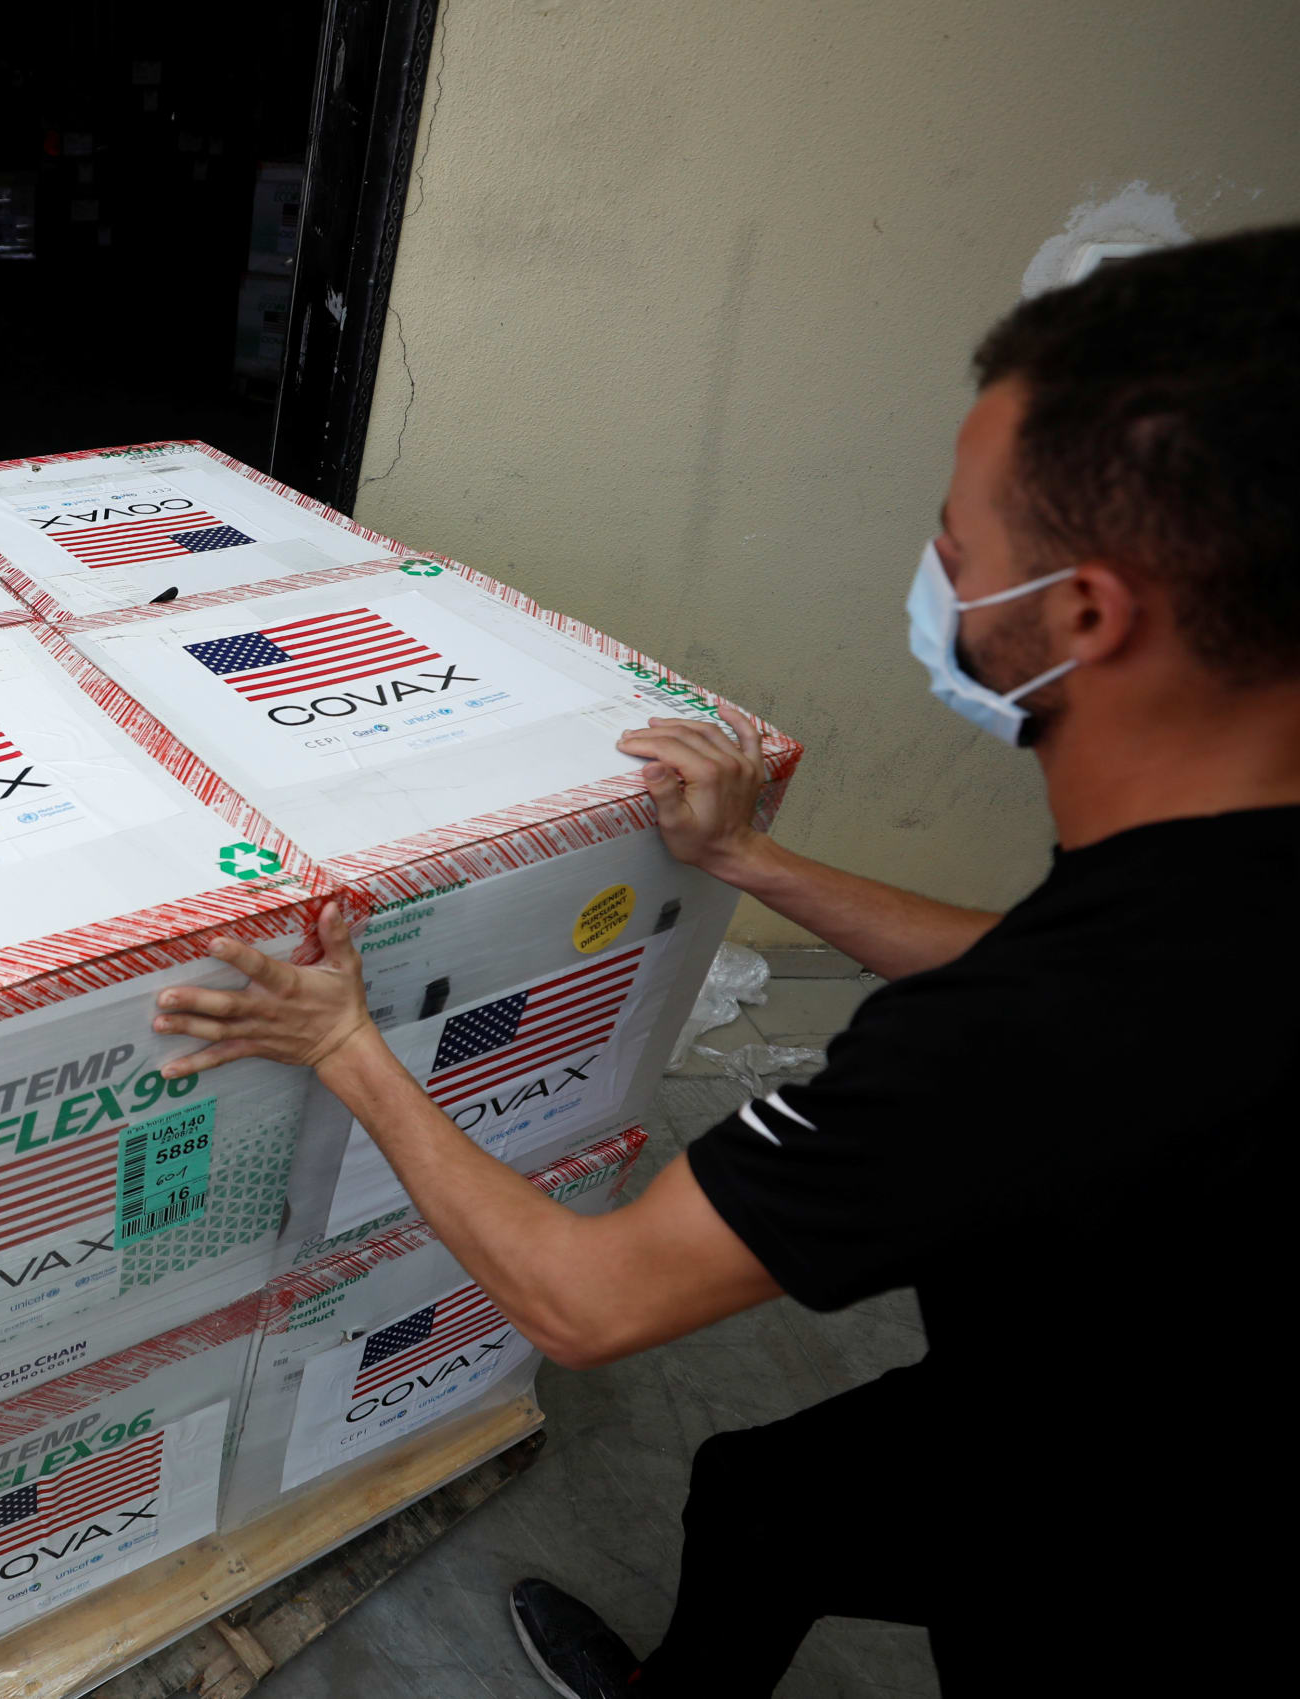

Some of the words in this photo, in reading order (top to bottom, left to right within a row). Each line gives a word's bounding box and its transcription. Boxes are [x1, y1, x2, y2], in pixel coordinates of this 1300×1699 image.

[28, 499, 193, 529] COVAX
[267, 664, 480, 727] COVAX
[304, 736, 341, 749] CEPI
[352, 726, 376, 737] Gavi
[403, 711, 439, 726] unicef
[369, 879, 467, 917] Temperature
[581, 887, 627, 920] SCREENED
[581, 895, 628, 929] PURSUANT
[364, 906, 435, 937] Sensitive
[580, 912, 629, 949] DIRECTIVES
[590, 922, 601, 932] TO
[360, 926, 422, 954] Product
[453, 1054, 600, 1131] OVAX
[152, 1113, 205, 1142] UA-140
[484, 1124, 519, 1145] unicef
[155, 1134, 209, 1165] 5888
[168, 1186, 190, 1205] 16
[10, 1292, 46, 1313] unicef
[291, 1271, 369, 1312] Temperature
[286, 1308, 336, 1333] Product
[288, 1294, 345, 1323] Sensitive
[34, 1340, 87, 1367] CHAIN
[345, 1330, 512, 1423] COVAX
[7, 1587, 29, 1601] Gavi
[55, 1559, 91, 1580] unicef
